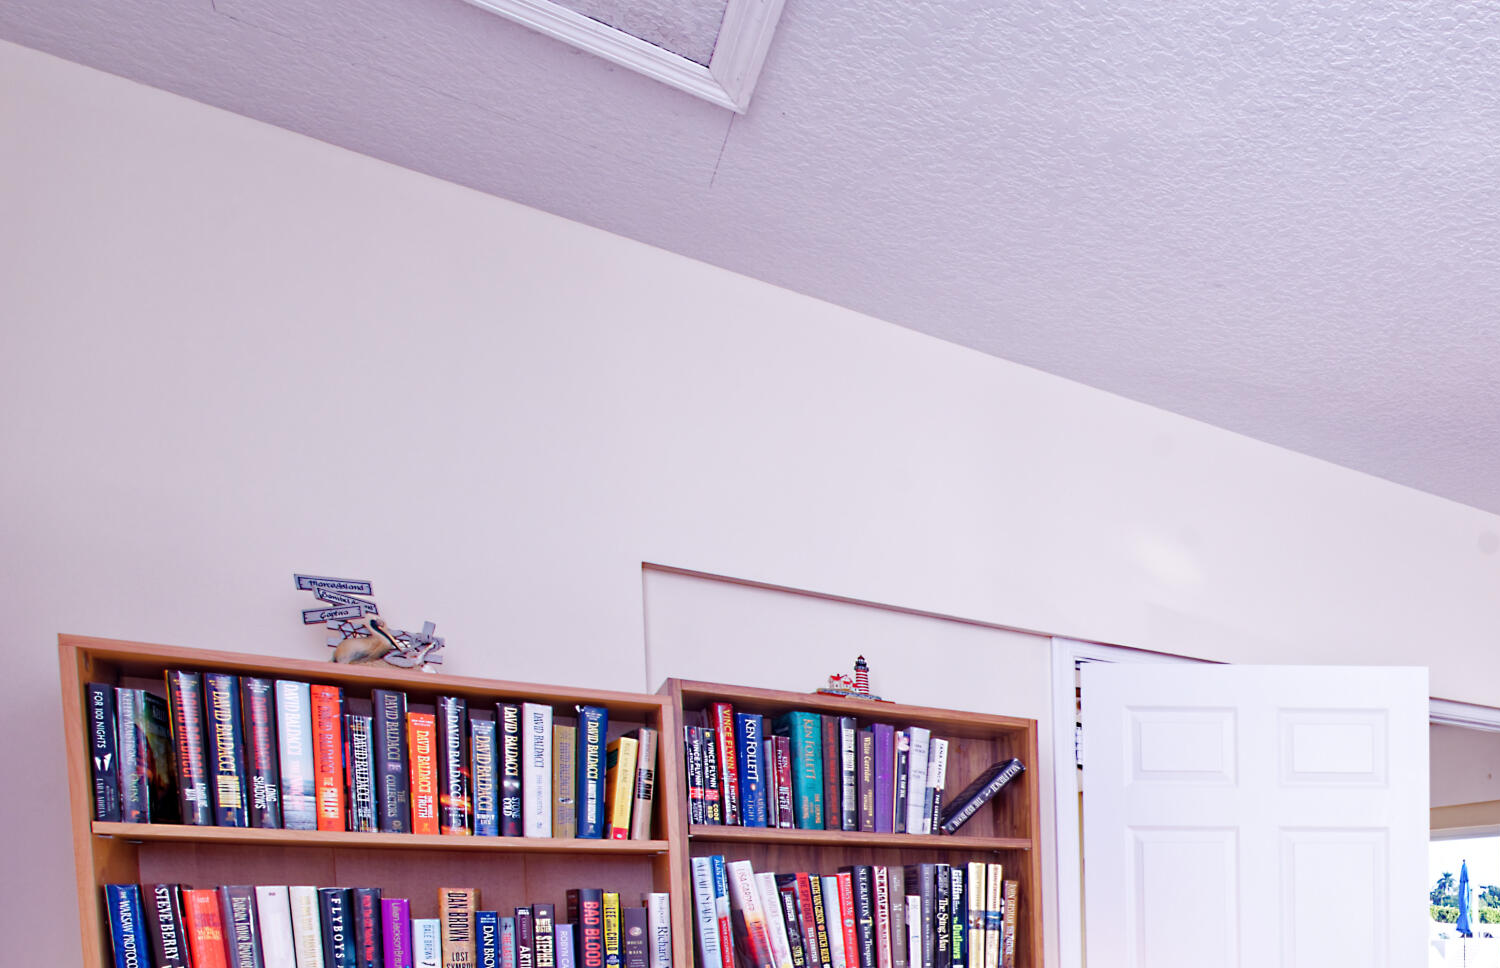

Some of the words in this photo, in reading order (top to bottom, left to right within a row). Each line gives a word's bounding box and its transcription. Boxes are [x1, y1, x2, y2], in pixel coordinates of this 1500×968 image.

[320, 610, 348, 619] Captiva
[94, 692, 103, 705] FOR
[213, 691, 232, 722] DAVID
[385, 694, 398, 724] DAVID
[95, 709, 104, 720] 100
[503, 707, 518, 737] DAVID
[722, 709, 732, 737] VINCE
[96, 721, 106, 748] NIGHTS
[416, 730, 429, 753] DAVID
[448, 714, 460, 749] DAVID
[587, 721, 599, 744] DAVID
[744, 719, 756, 742] KEN
[803, 719, 813, 739] KEN
[216, 724, 236, 772] BALDACCI
[387, 726, 401, 761] BALDACCI
[476, 735, 491, 764] DAVID
[504, 734, 519, 776] BALDACCI
[707, 741, 715, 763] VINCE
[725, 737, 734, 771] FLYNN
[863, 736, 872, 754] White
[417, 753, 431, 793] BALDACCI
[587, 744, 599, 780] BALDACCI
[746, 741, 759, 782] FOLLETT
[804, 741, 816, 780] FOLLETT
[863, 755, 873, 782] Corridor
[355, 759, 370, 802] BALDACCI
[450, 750, 461, 804] BALDACCI
[477, 765, 495, 812] BALDACCI
[709, 763, 717, 788] FLYNN
[253, 776, 266, 809] SHADOWS
[265, 784, 276, 801] LONG
[386, 775, 397, 817] COLLECTORS
[779, 786, 790, 810] NEVER
[417, 796, 428, 818] TRUTH
[715, 859, 723, 878] ALAN
[800, 877, 808, 889] THE
[801, 890, 809, 902] SPY
[952, 870, 963, 900] Griffin
[155, 887, 173, 921] STEVE
[448, 893, 467, 909] DAN
[583, 901, 599, 925] BAD
[605, 907, 616, 918] LEE
[803, 903, 813, 923] COAST
[860, 882, 869, 919] GRAFTON
[940, 898, 949, 912] The
[119, 901, 133, 932] WARSAW
[330, 898, 345, 959] FLYBOYS
[448, 912, 469, 942] BROWN
[937, 912, 949, 933] Sting
[160, 923, 179, 960] BERRY
[483, 925, 494, 947] DAN
[560, 930, 569, 956] ROBYN
[584, 928, 600, 967] BLOOD
[606, 932, 618, 951] CHILD
[657, 926, 670, 963] Richard
[818, 932, 827, 947] DITCH
[939, 934, 949, 952] Man
[953, 924, 964, 960] Outlaws
[451, 952, 468, 962] LOST
[536, 935, 553, 967] STEPHEN
[809, 939, 817, 962] GERRITSEN
[820, 948, 830, 962] RIDER
[864, 939, 872, 966] Trespass
